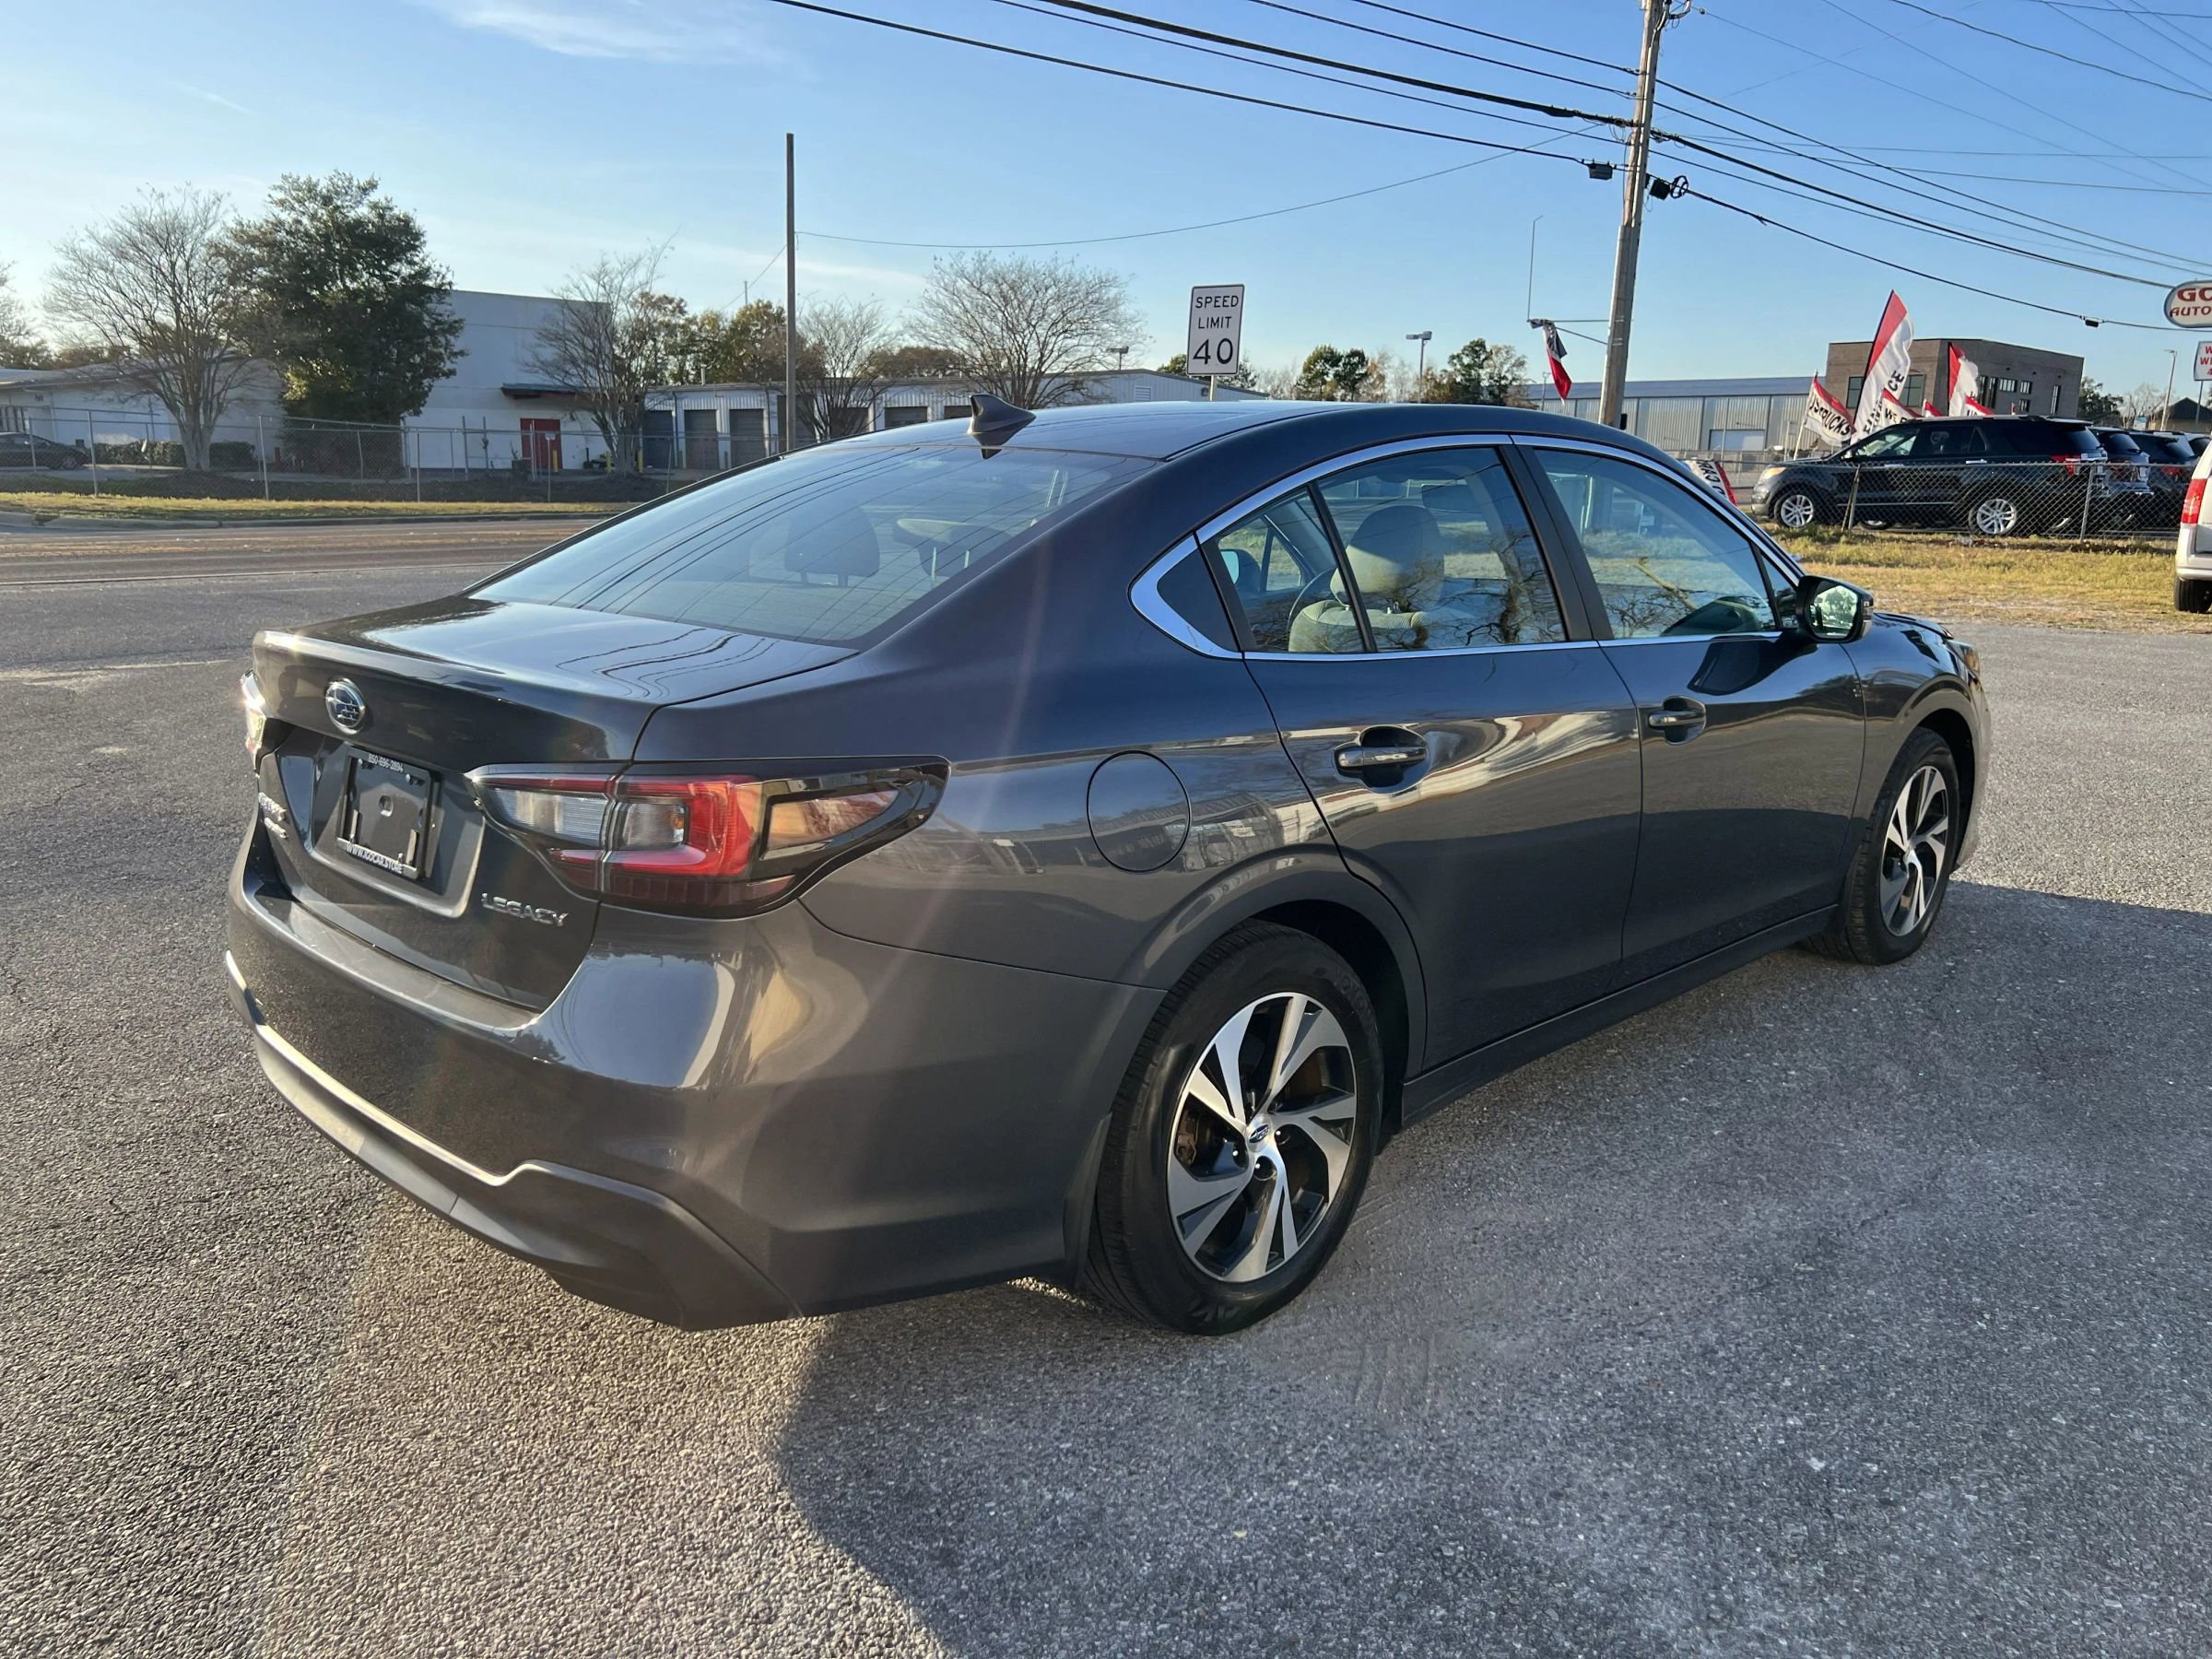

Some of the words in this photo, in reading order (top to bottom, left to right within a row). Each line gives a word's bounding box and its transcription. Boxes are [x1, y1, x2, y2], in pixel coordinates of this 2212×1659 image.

[1194, 295, 1239, 309] SPEED
[1197, 316, 1232, 329] LIMIT
[1193, 337, 1233, 365] 40
[481, 892, 569, 926] LEGACY
